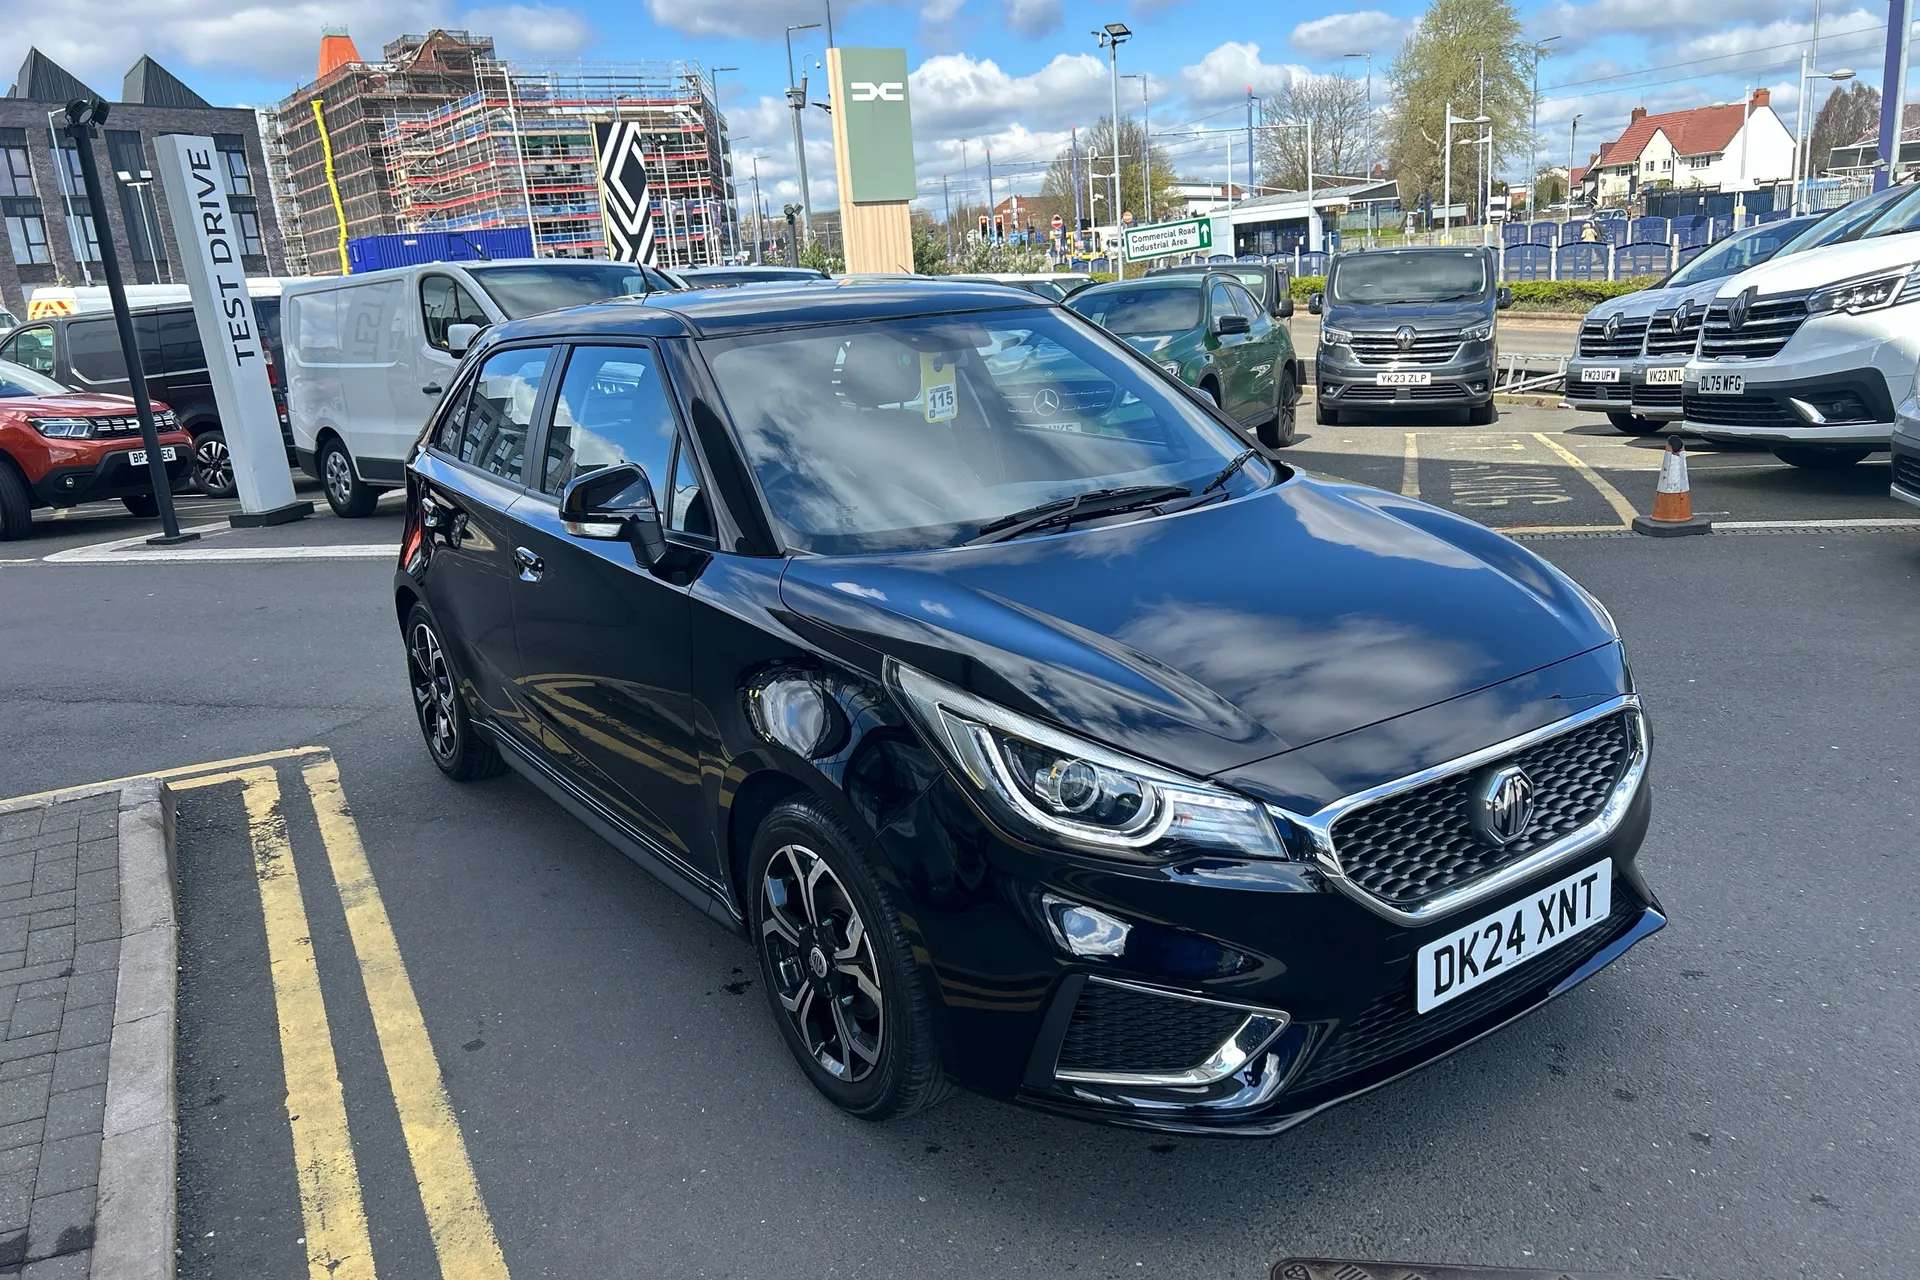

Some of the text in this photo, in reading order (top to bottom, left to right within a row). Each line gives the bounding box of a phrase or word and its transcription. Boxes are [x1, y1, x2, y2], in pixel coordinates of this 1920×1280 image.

[1131, 226, 1197, 244] Commercial Road
[1132, 238, 1188, 253] Industrial Area
[187, 148, 255, 367] TEST DRIVE
[1381, 374, 1427, 383] YK23 ZLP
[1668, 370, 1683, 381] NTL
[1701, 375, 1721, 391] DL75
[930, 391, 953, 408] 115
[1491, 771, 1532, 838] MG
[1433, 872, 1598, 997] DK24 XNT
